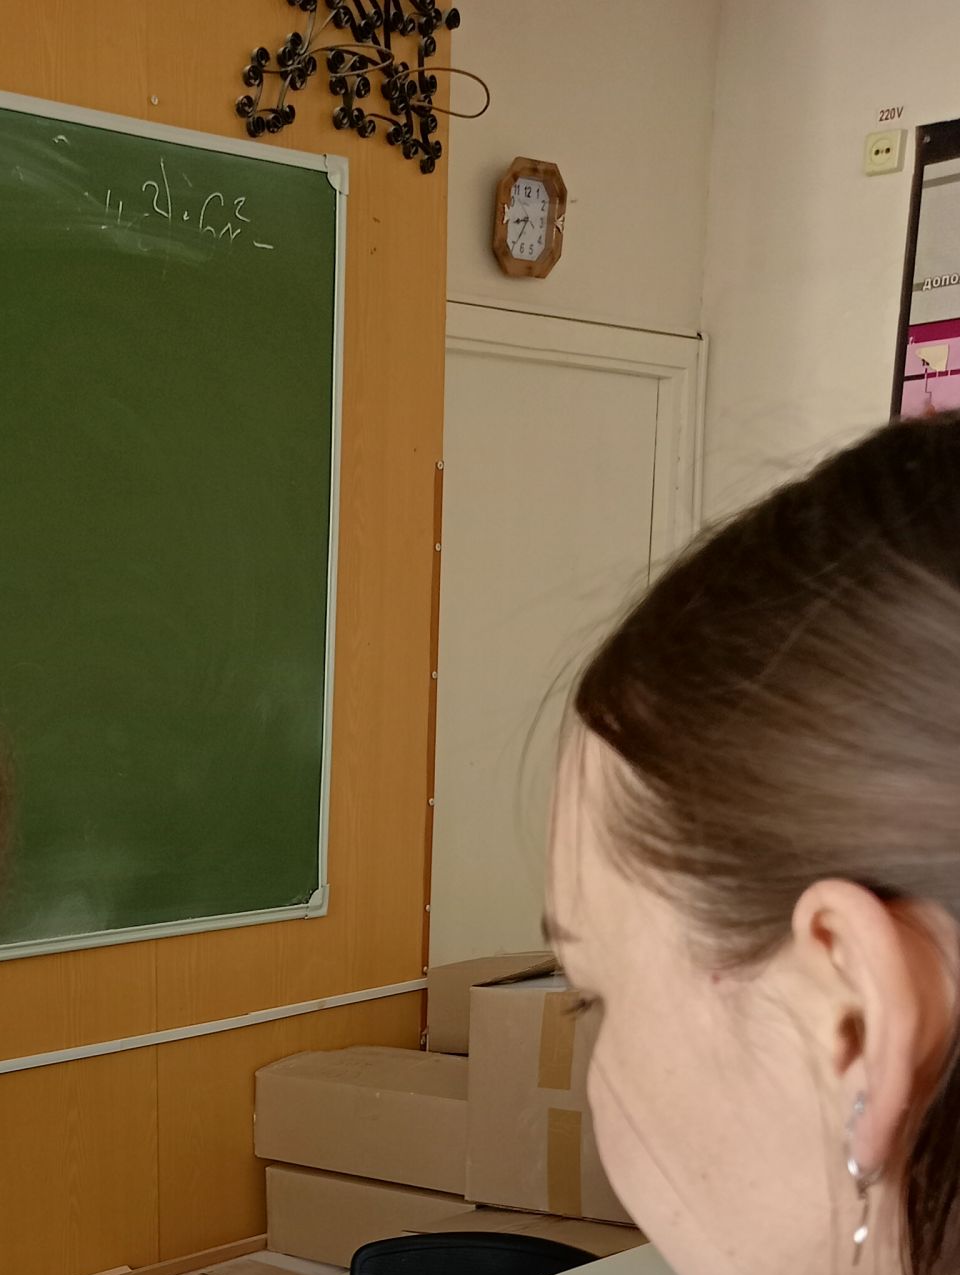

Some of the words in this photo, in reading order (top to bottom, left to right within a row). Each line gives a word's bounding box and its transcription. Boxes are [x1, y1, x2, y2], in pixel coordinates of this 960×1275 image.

[879, 106, 904, 122] 220V
[524, 185, 532, 198] 12
[541, 199, 546, 212] 2
[520, 242, 525, 254] 6
[529, 243, 534, 255] 5
[922, 273, 960, 291] допо
